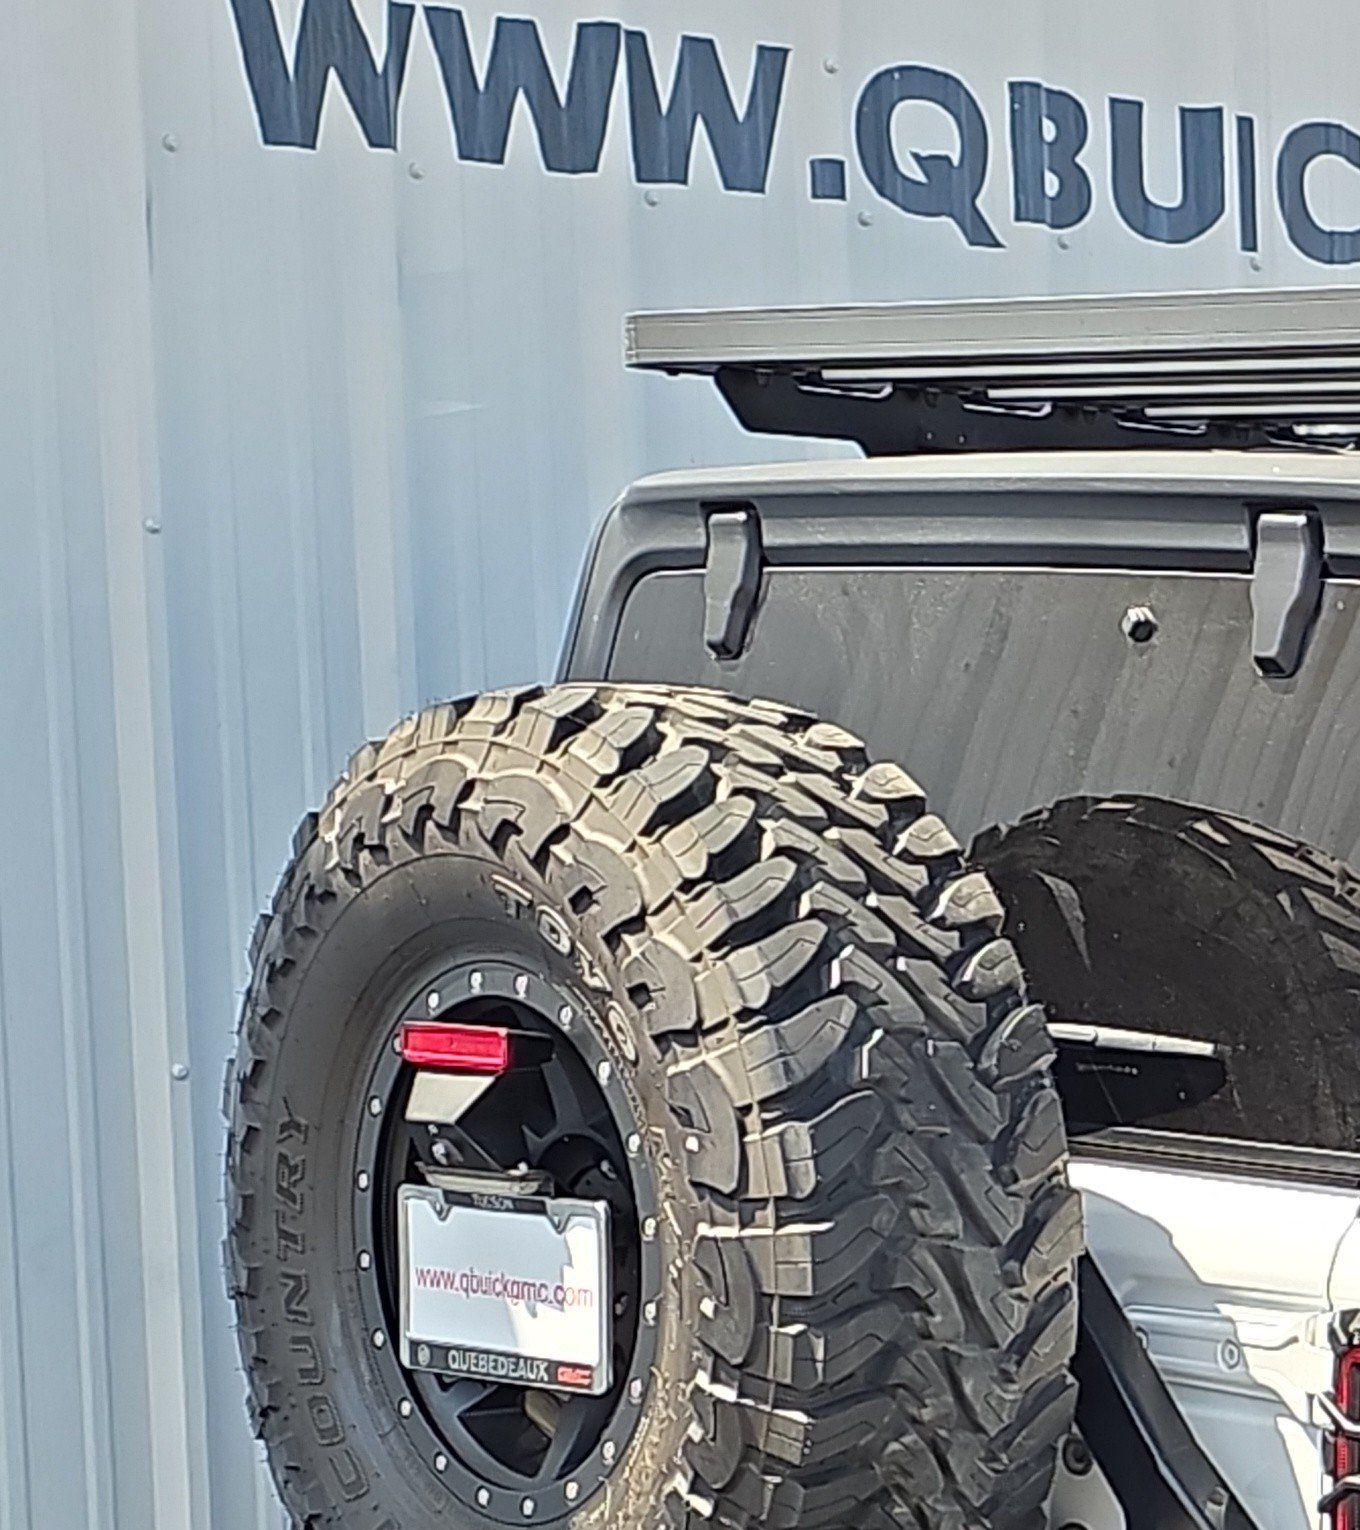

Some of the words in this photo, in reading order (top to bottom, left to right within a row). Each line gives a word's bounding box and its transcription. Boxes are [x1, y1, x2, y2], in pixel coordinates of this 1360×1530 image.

[491, 872, 640, 1067] TOYO
[276, 1096, 370, 1502] COUNTRY
[415, 1266, 593, 1308] www.qbuickgmc.com
[447, 1349, 549, 1383] QUEBEDEAUX
